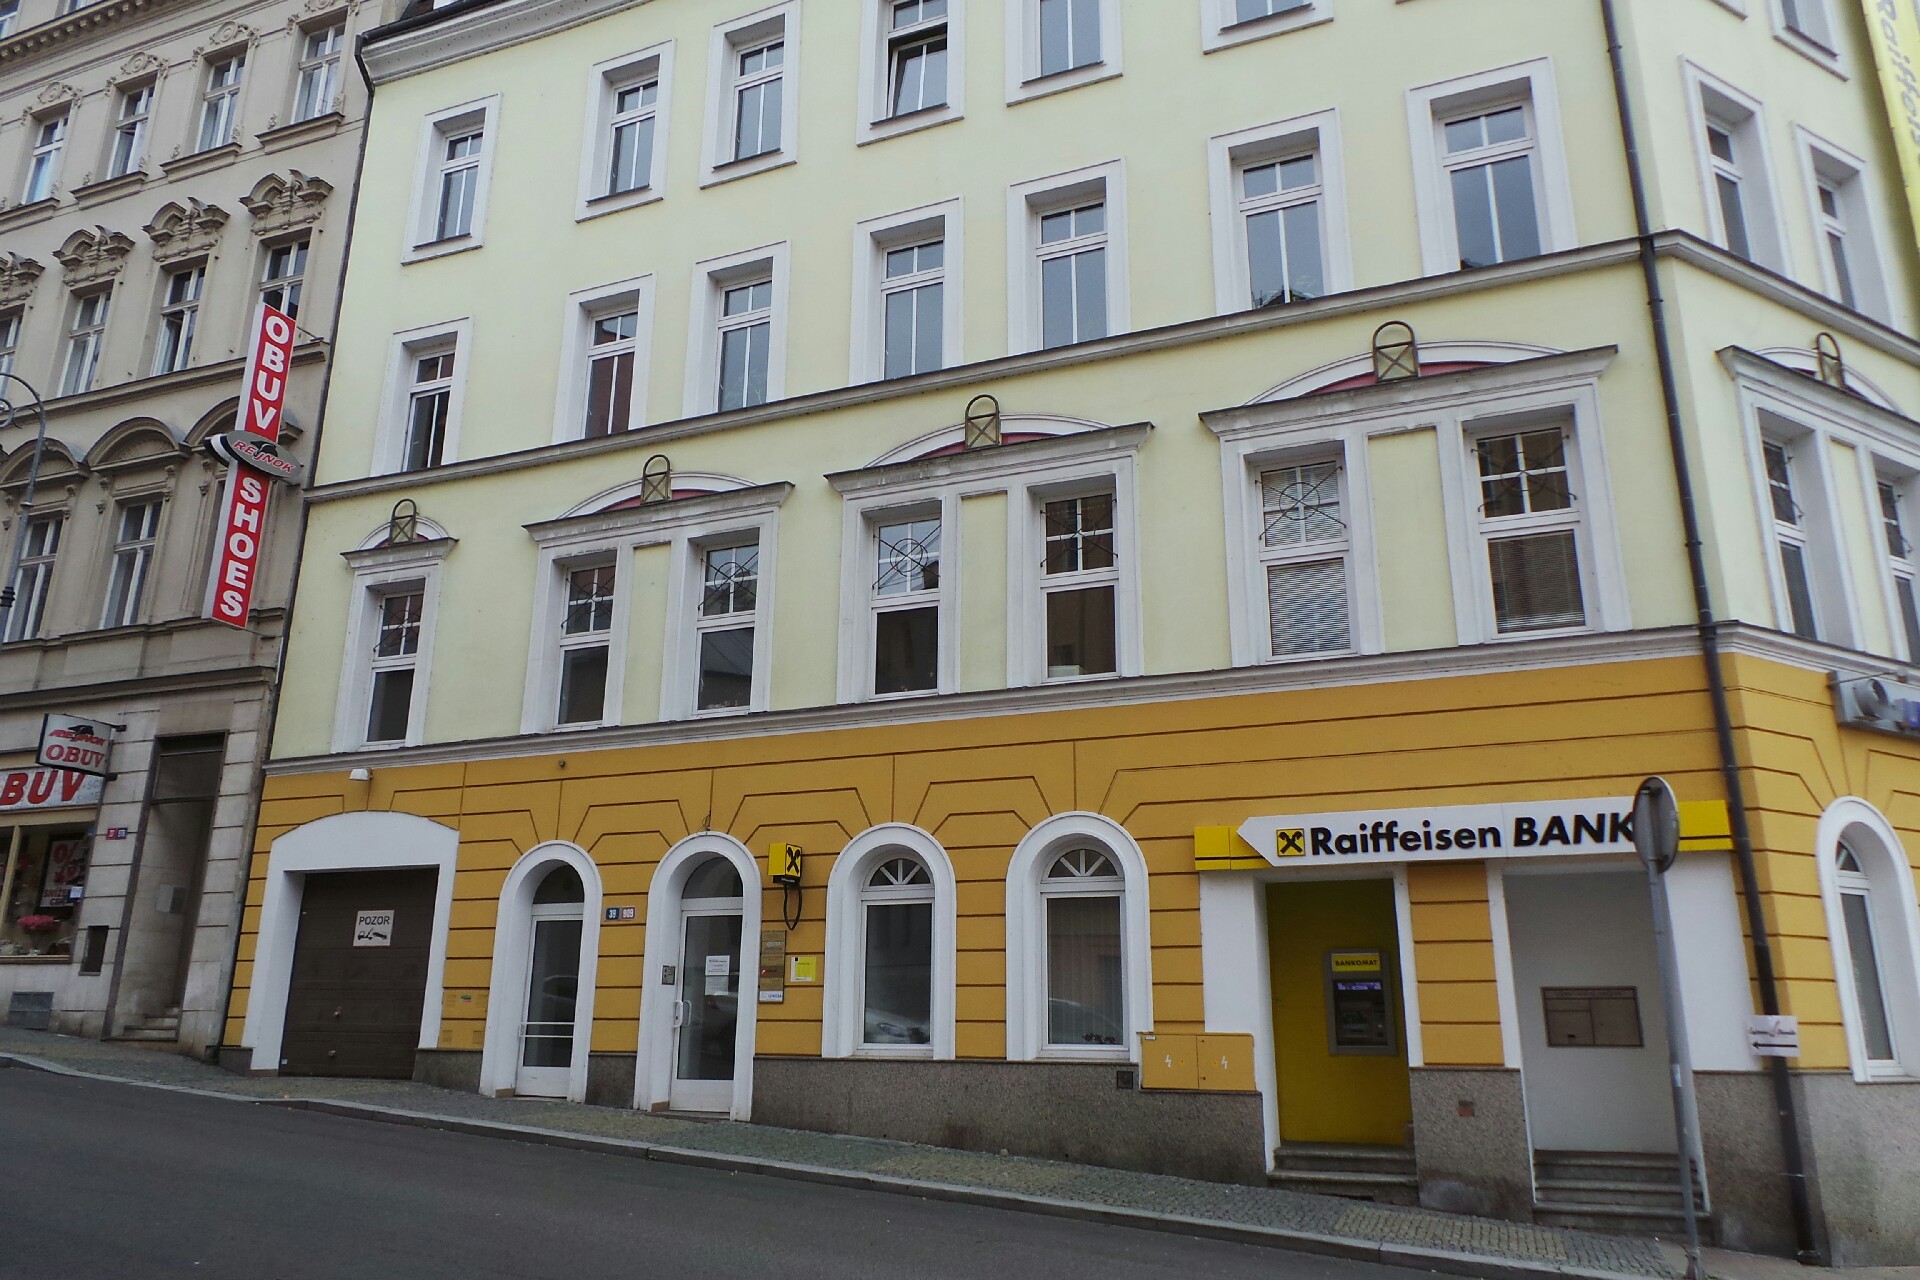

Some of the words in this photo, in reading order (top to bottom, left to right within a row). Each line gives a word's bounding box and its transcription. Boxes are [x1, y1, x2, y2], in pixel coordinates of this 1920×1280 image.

[252, 315, 291, 430] OBUV
[233, 440, 296, 474] REJNOK
[220, 476, 262, 617] SHOES
[46, 744, 105, 768] OBUV
[1311, 819, 1502, 856] Raiffeisen
[1514, 811, 1634, 847] BANK
[359, 915, 390, 926] POZOR
[608, 909, 617, 919] 39
[1335, 959, 1378, 967] BANKOMAT
